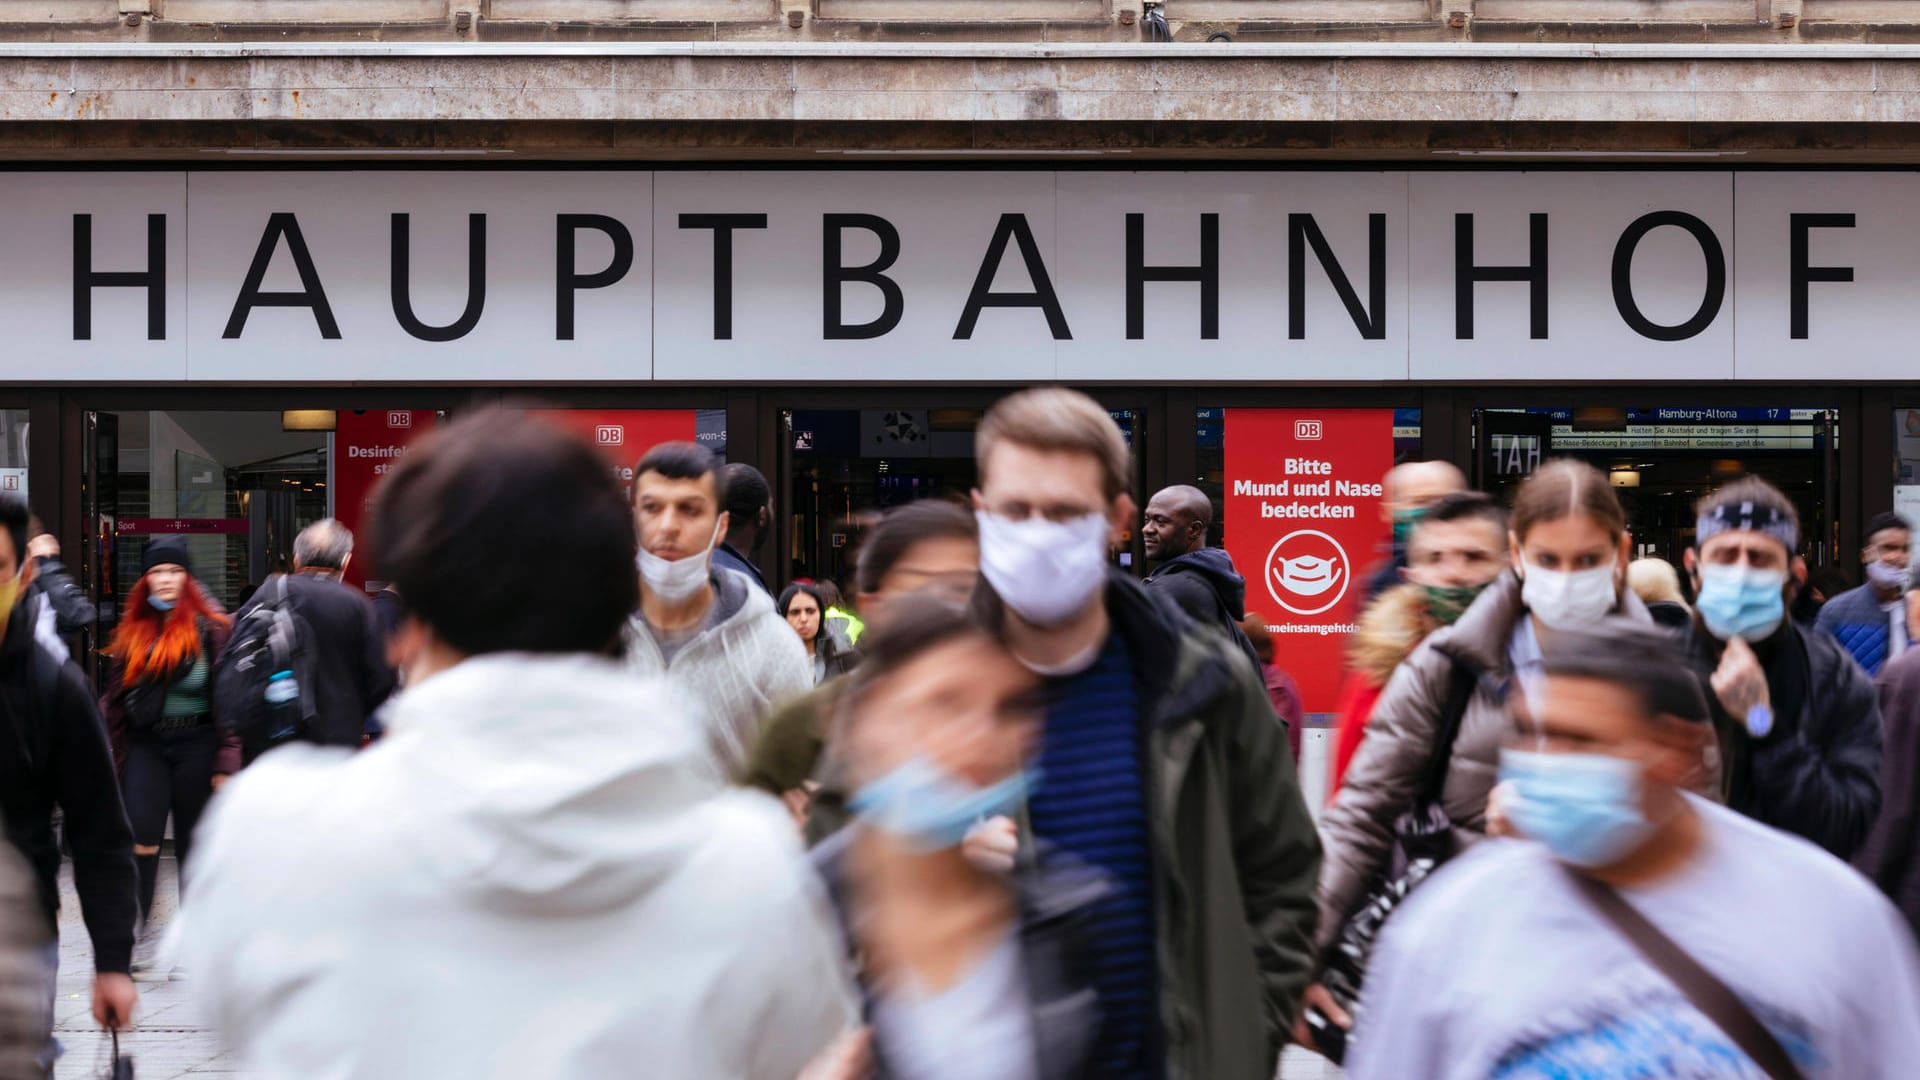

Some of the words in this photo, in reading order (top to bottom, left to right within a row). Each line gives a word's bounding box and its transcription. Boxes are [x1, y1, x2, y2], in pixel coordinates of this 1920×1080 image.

[72, 211, 1857, 342] HAUPTBAHNHOF
[389, 413, 409, 426] DB
[1659, 409, 1737, 420] Hamburg-Altona
[1767, 409, 1779, 419] 17
[599, 428, 621, 443] DB
[1298, 423, 1320, 437] DB
[1710, 427, 1732, 435] tragen
[1735, 440, 1750, 448] geht
[1284, 458, 1332, 475] Bitte
[1233, 480, 1289, 496] Mund
[1293, 480, 1331, 496] und
[1335, 481, 1383, 496] Nase
[1261, 502, 1355, 518] bedecken
